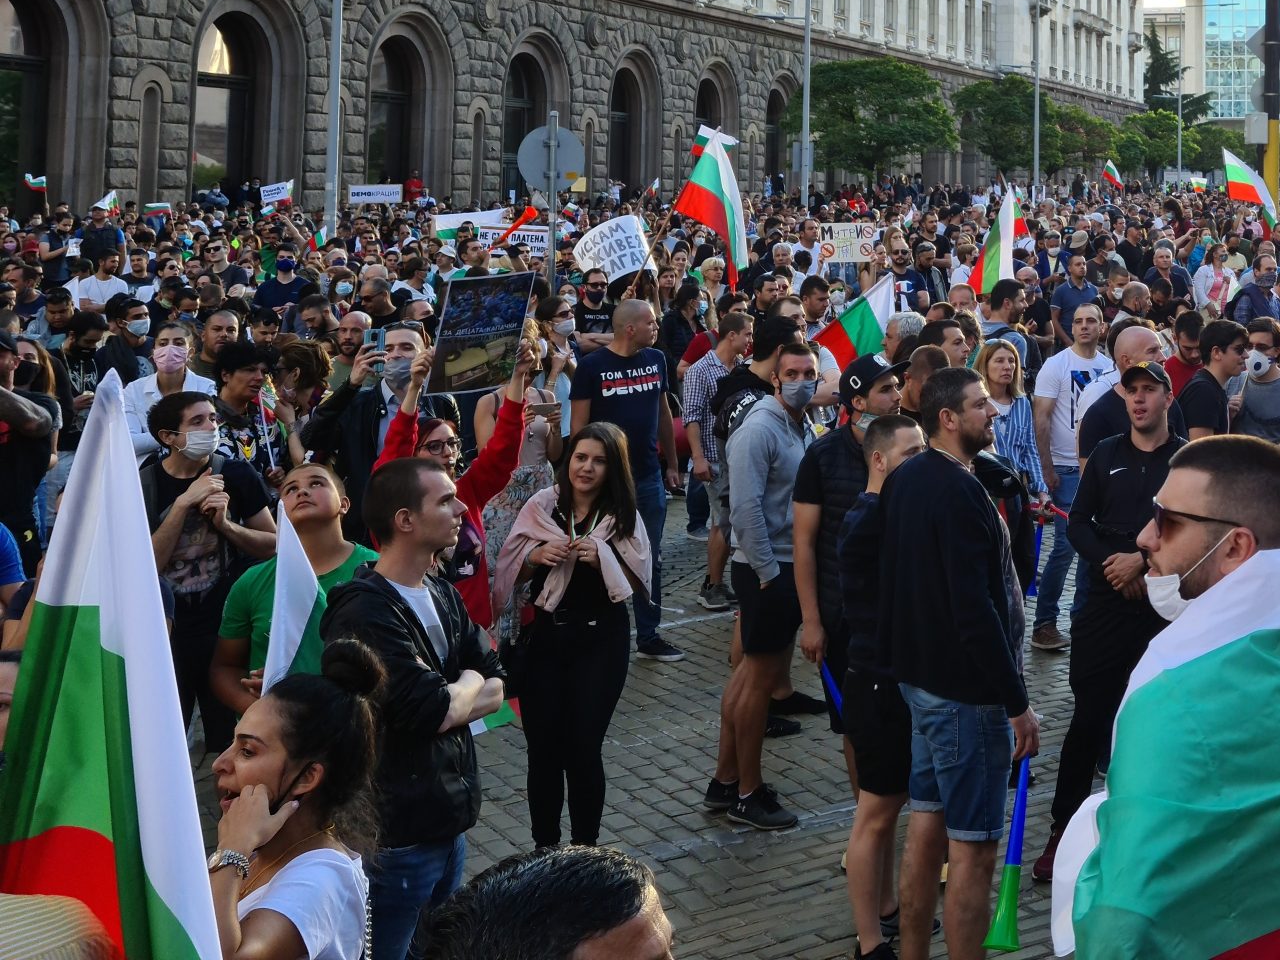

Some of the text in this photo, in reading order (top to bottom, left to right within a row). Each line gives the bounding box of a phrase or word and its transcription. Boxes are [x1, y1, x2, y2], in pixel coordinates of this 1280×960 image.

[480, 231, 489, 240] НЕ
[577, 222, 627, 261] ИСКАМ
[588, 234, 645, 268] ЖИВЕЯ
[600, 365, 659, 381] TOM TAILOR
[601, 374, 662, 397] DENIM
